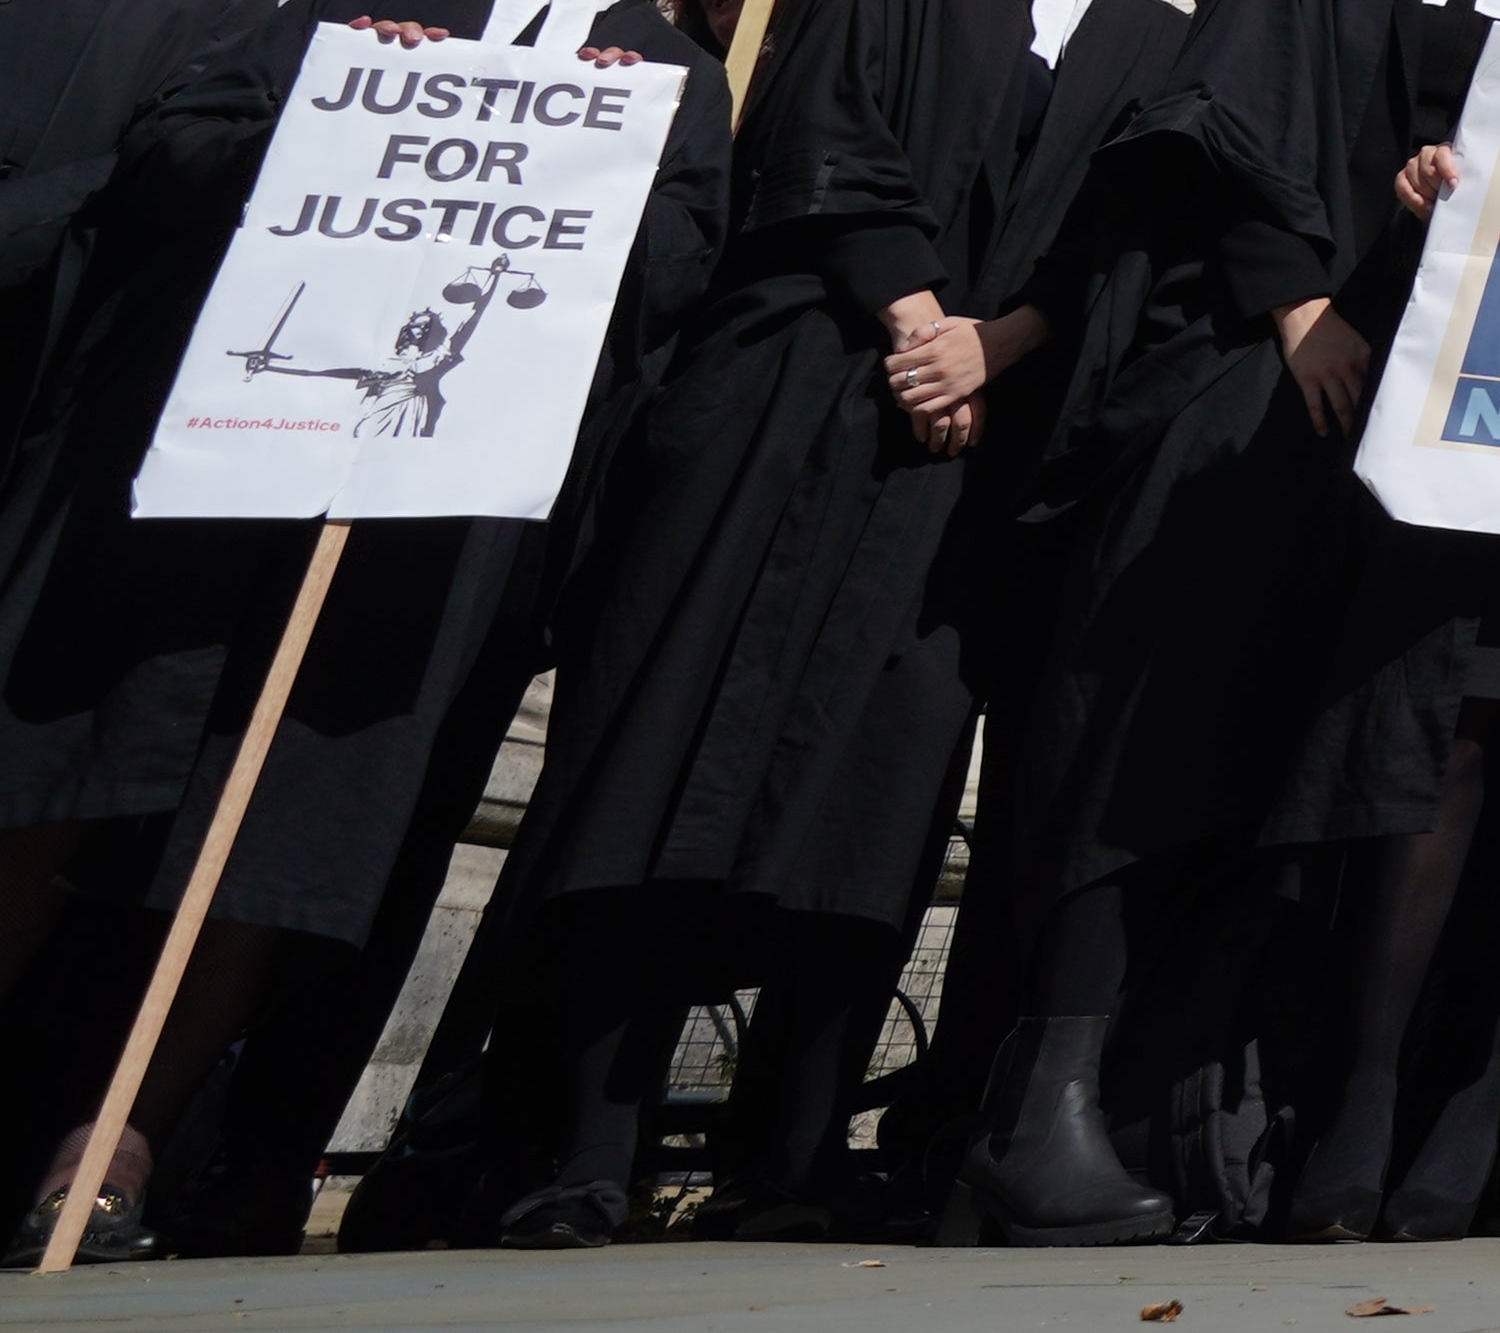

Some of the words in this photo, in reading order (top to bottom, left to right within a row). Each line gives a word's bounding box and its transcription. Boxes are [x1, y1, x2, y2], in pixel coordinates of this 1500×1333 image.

[311, 66, 632, 131] JUSTICE
[375, 134, 530, 185] FOR
[266, 193, 595, 251] JUSTICE
[185, 416, 341, 432] #Action4Justice
